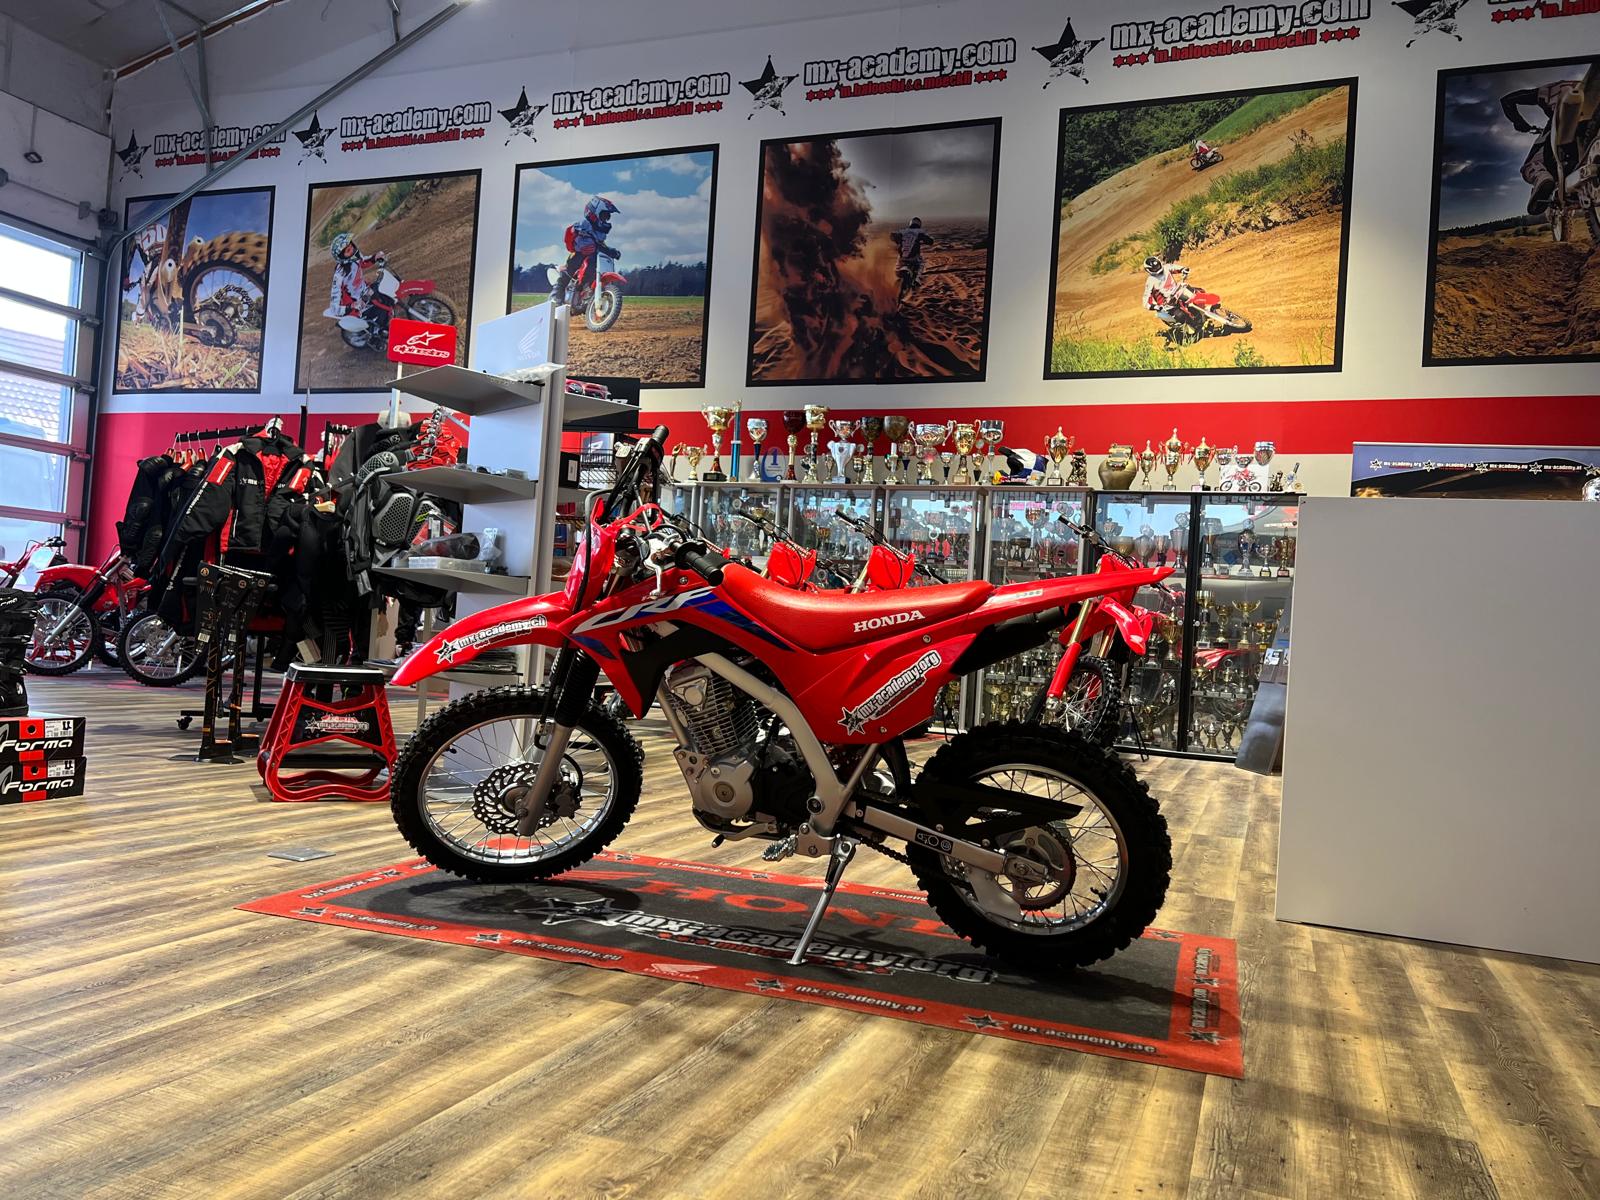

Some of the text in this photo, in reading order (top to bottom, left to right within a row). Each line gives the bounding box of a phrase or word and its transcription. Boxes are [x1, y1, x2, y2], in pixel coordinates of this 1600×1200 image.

[803, 38, 1016, 86] mx-academy.com
[552, 72, 730, 115] mx-academy.com
[340, 101, 492, 138] mx-academy.com
[853, 609, 926, 633] HONDA
[858, 651, 941, 719] mx-academy.org
[2, 779, 74, 794] Forma
